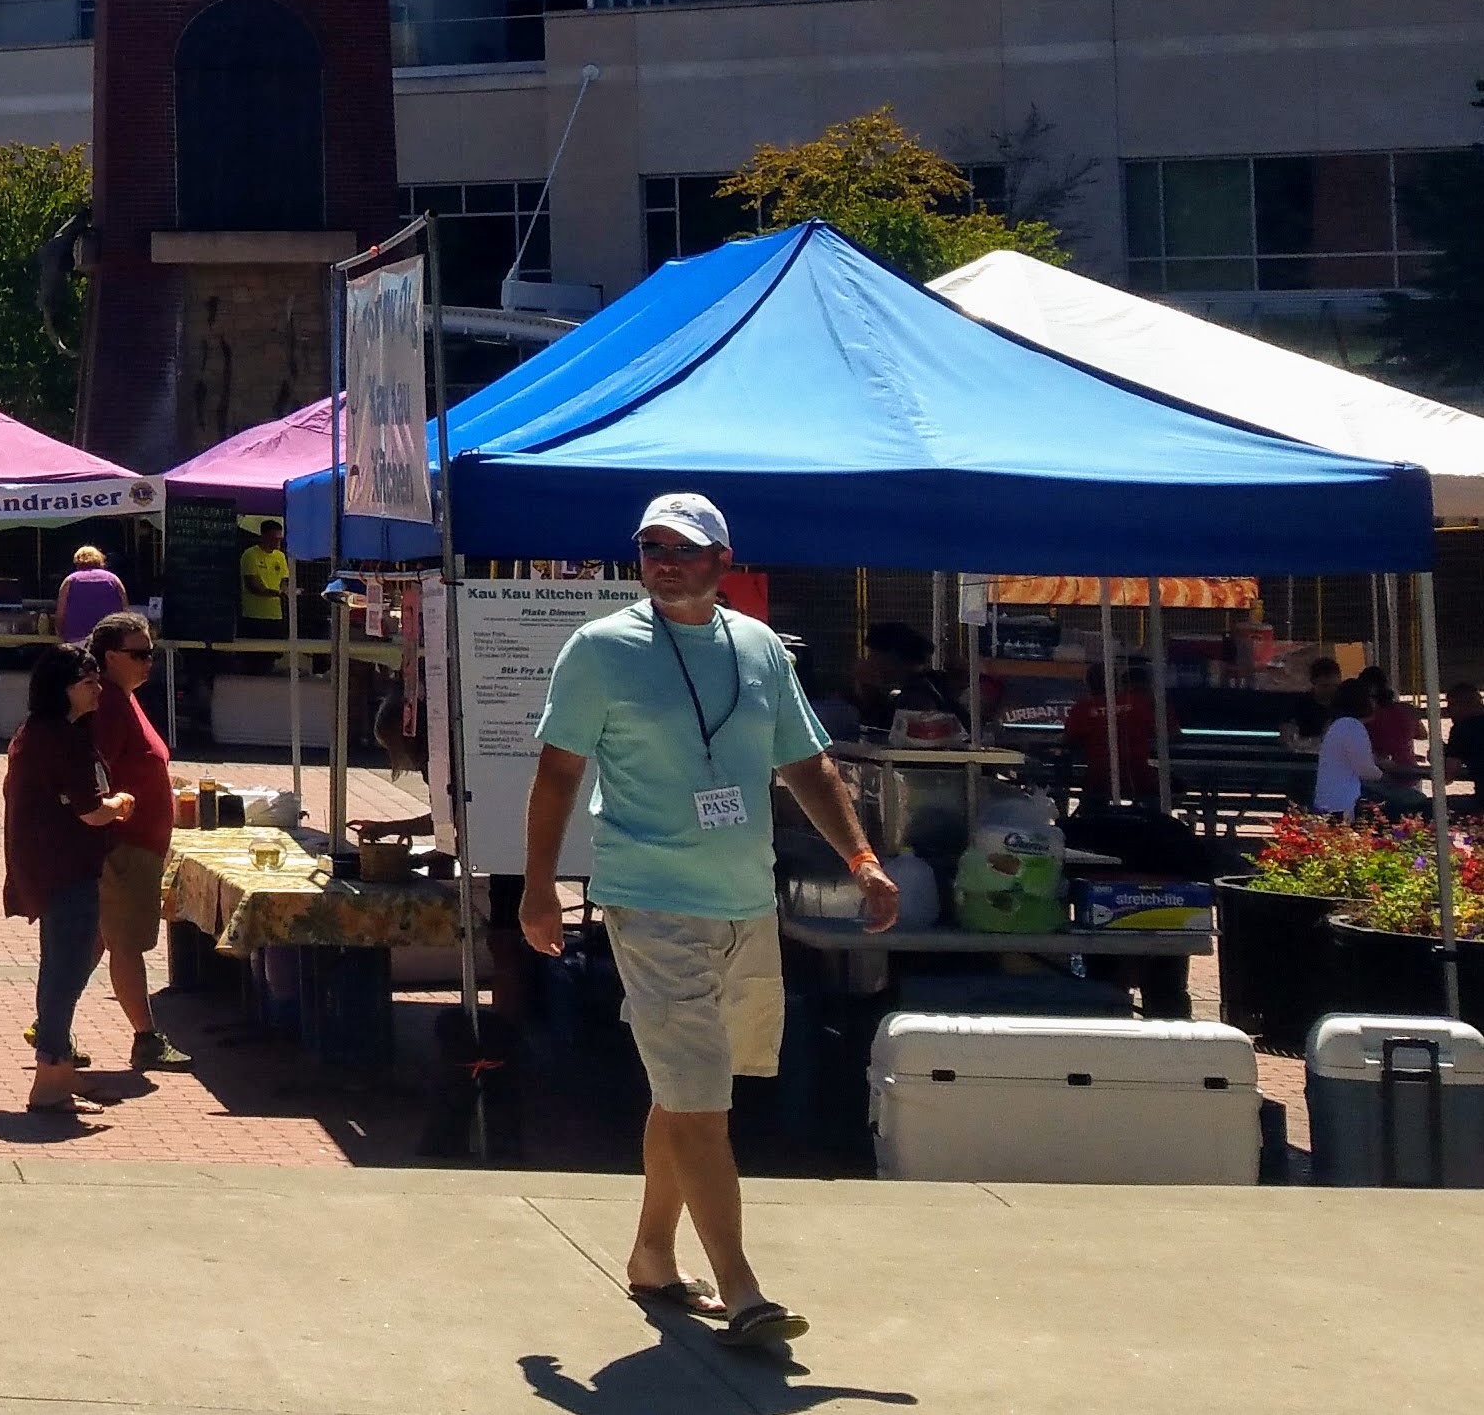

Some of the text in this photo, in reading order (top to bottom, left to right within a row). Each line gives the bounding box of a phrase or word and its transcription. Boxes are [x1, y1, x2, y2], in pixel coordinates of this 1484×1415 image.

[468, 588, 639, 600] Kau Kau Kitchen Menu
[549, 608, 586, 616] Dinners
[520, 667, 535, 675] Fry
[1005, 706, 1059, 722] URBAN
[701, 798, 740, 816] PASS
